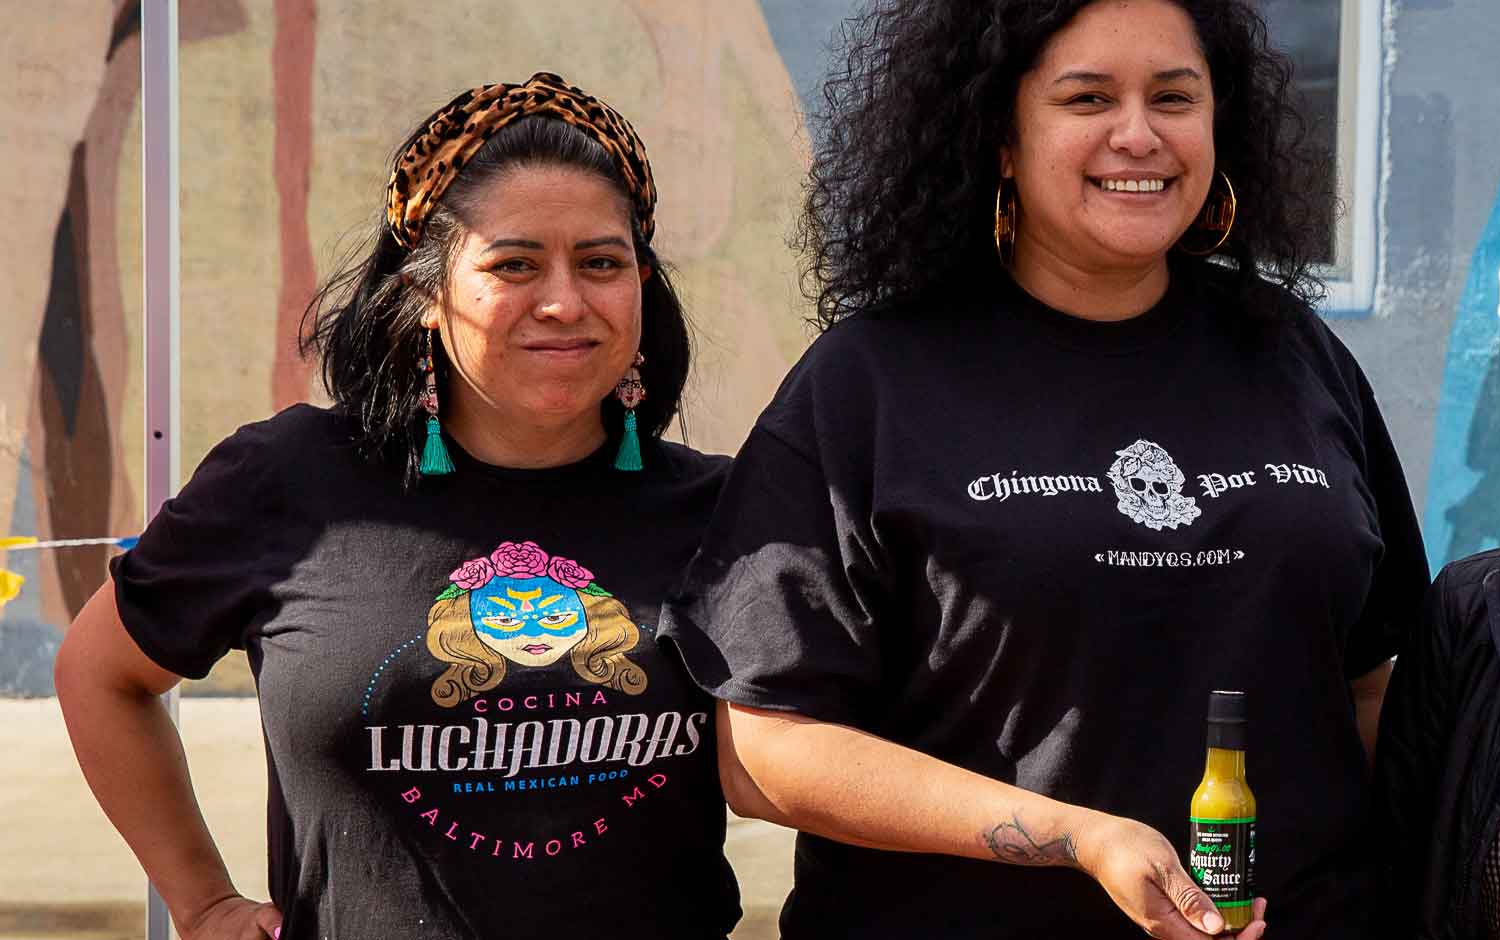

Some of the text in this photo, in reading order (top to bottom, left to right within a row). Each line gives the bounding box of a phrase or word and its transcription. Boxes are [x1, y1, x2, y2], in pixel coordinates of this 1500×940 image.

[967, 463, 1331, 503] Chingona Por Vida
[473, 690, 608, 713] COCINA
[364, 711, 708, 779] LUCHADORAS
[453, 768, 630, 794] REAL MEXICAN FOOD
[401, 773, 667, 860] BALTIMORE MD
[1190, 850, 1232, 871] Squirty
[1202, 869, 1241, 886] Sauce
